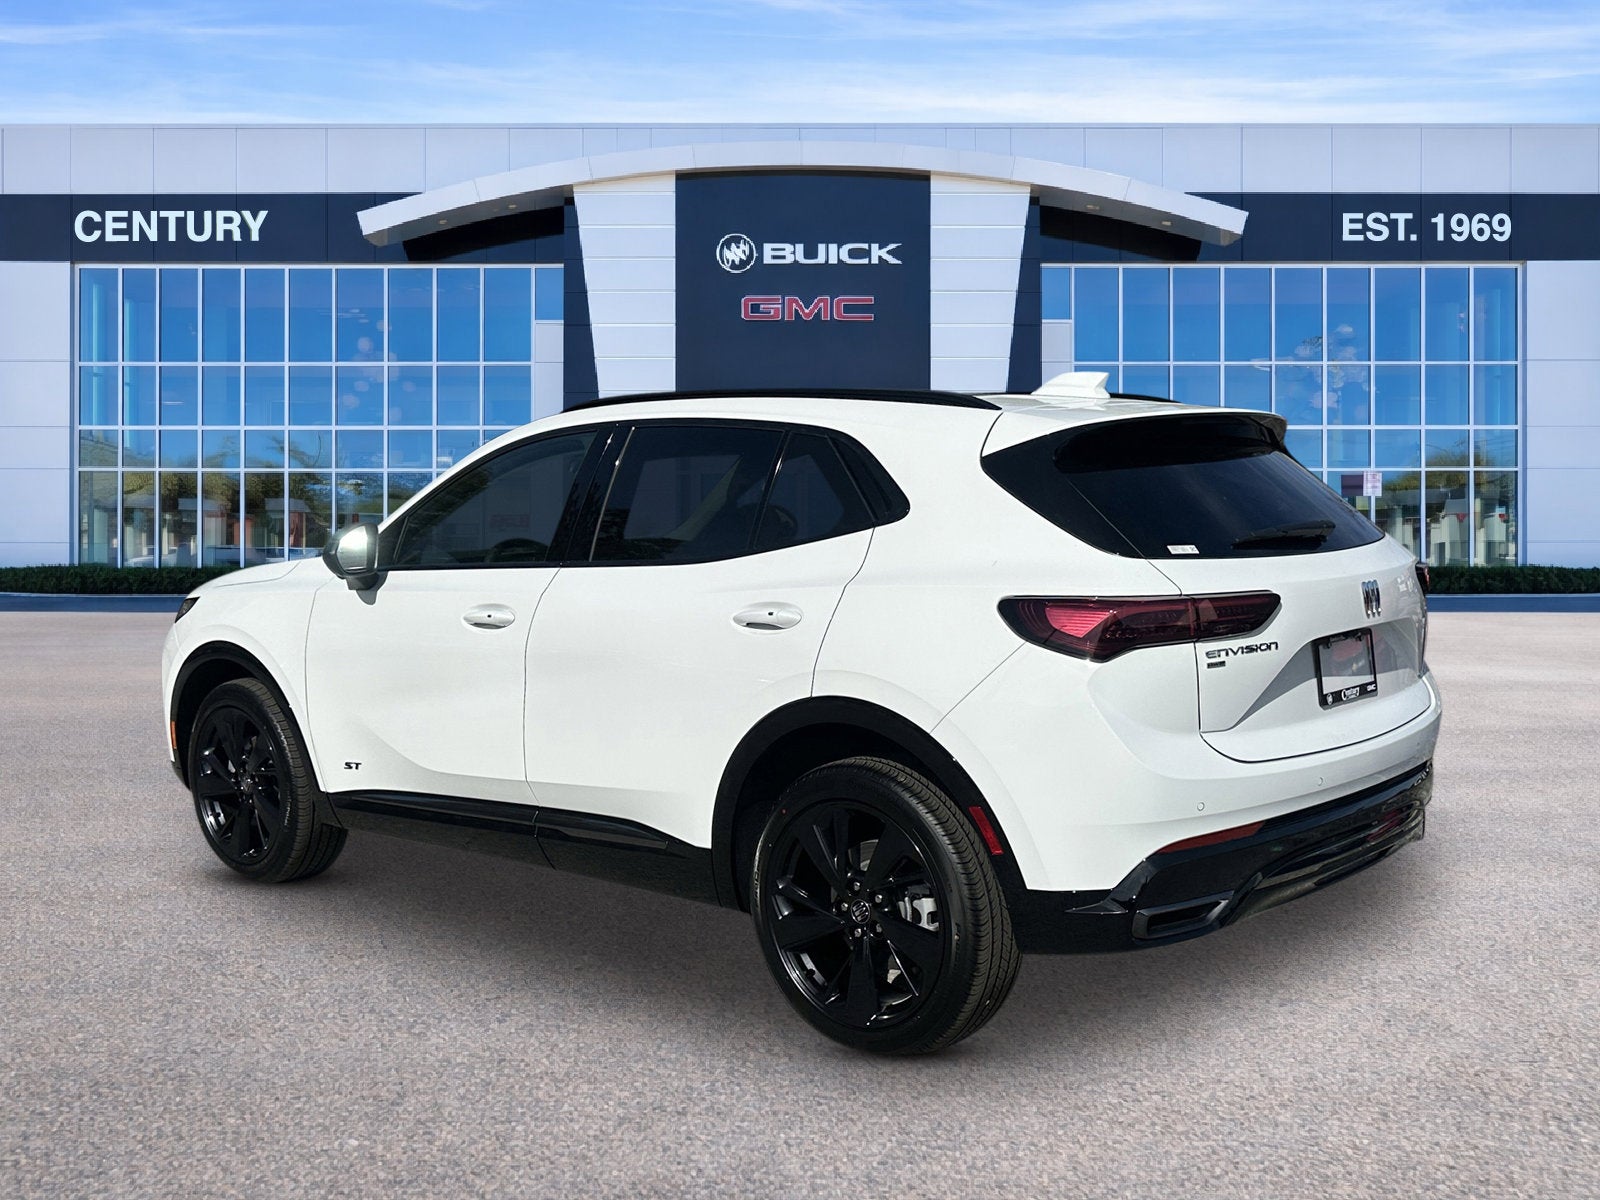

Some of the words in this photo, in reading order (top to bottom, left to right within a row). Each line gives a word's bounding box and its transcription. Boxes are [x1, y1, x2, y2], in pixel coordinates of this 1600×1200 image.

[74, 210, 269, 243] CENTURY
[1342, 212, 1418, 242] EST.
[1431, 213, 1512, 242] 1969
[763, 243, 903, 265] BUICK
[741, 295, 875, 321] GMC
[1205, 641, 1279, 659] ENVISION
[343, 761, 362, 770] ST
